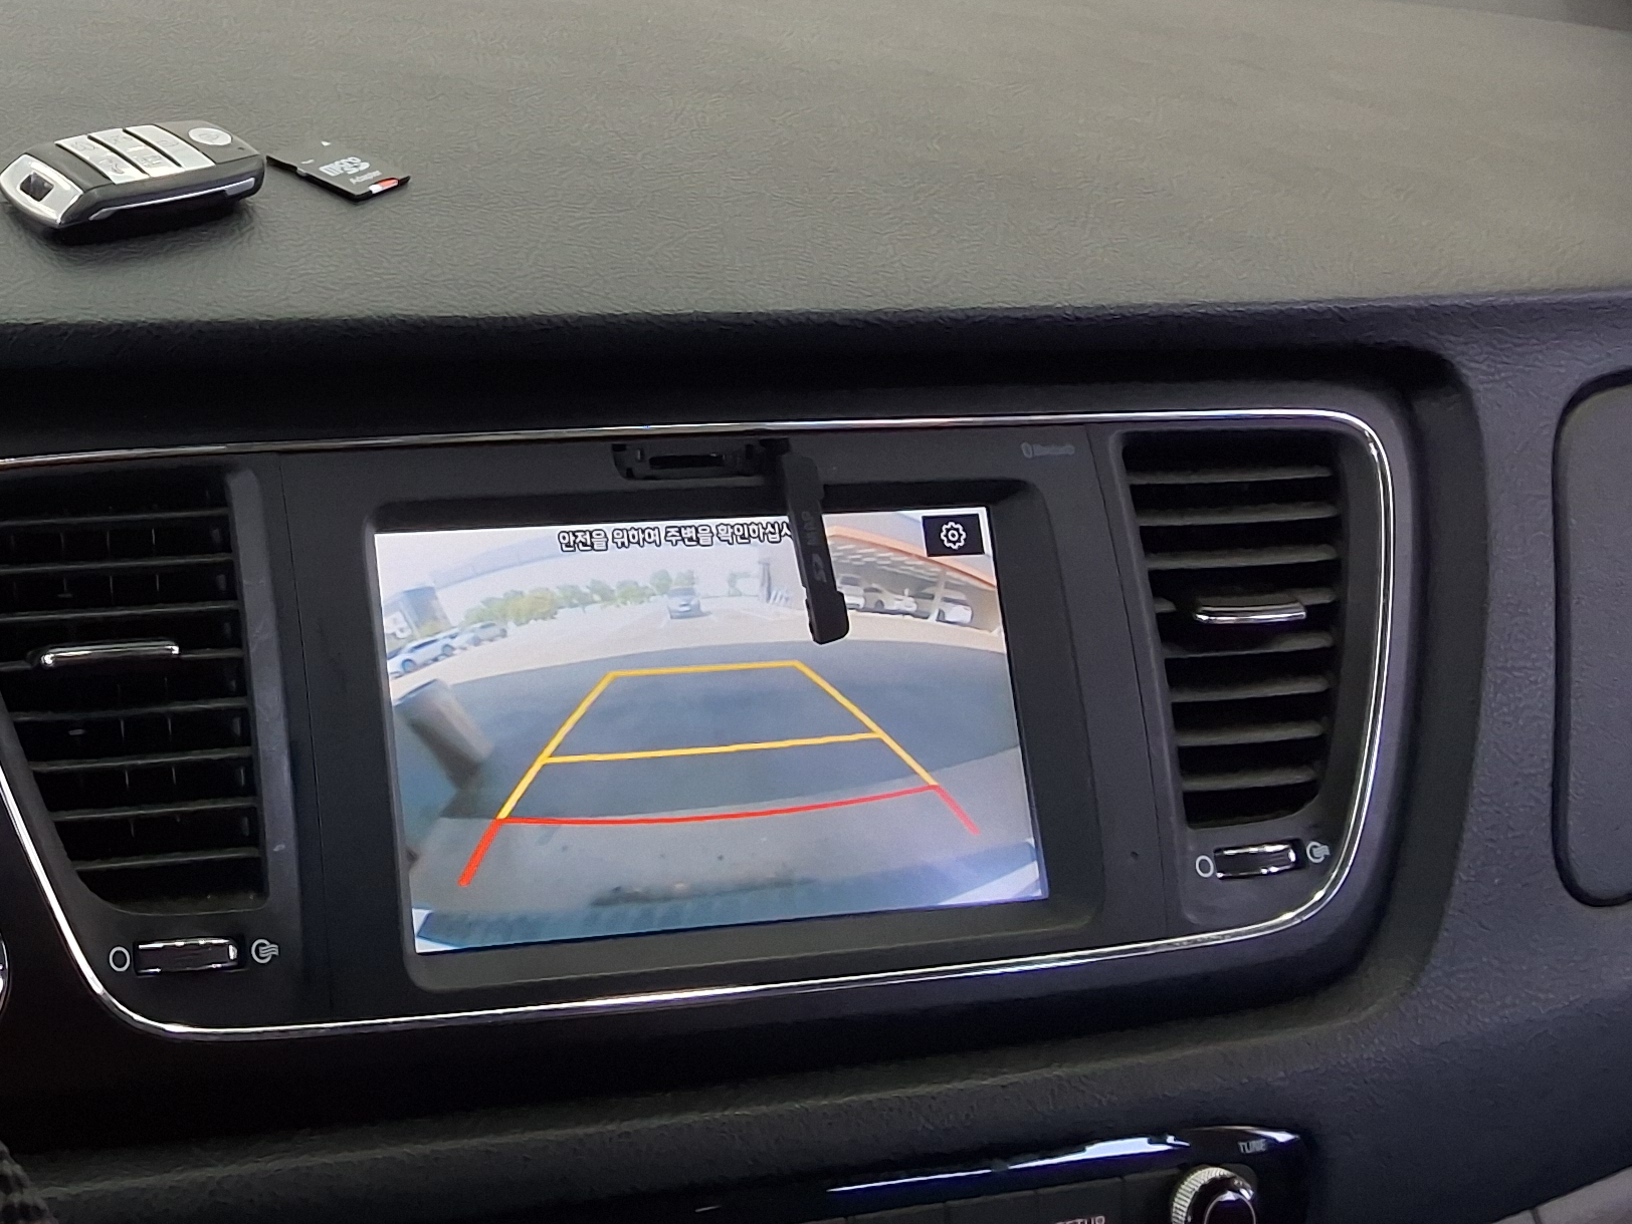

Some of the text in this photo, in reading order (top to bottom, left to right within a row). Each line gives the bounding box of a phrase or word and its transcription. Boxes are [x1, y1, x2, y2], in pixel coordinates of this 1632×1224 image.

[558, 530, 609, 552] 안전을
[612, 527, 662, 549] 위하여
[665, 525, 714, 547] 주변을
